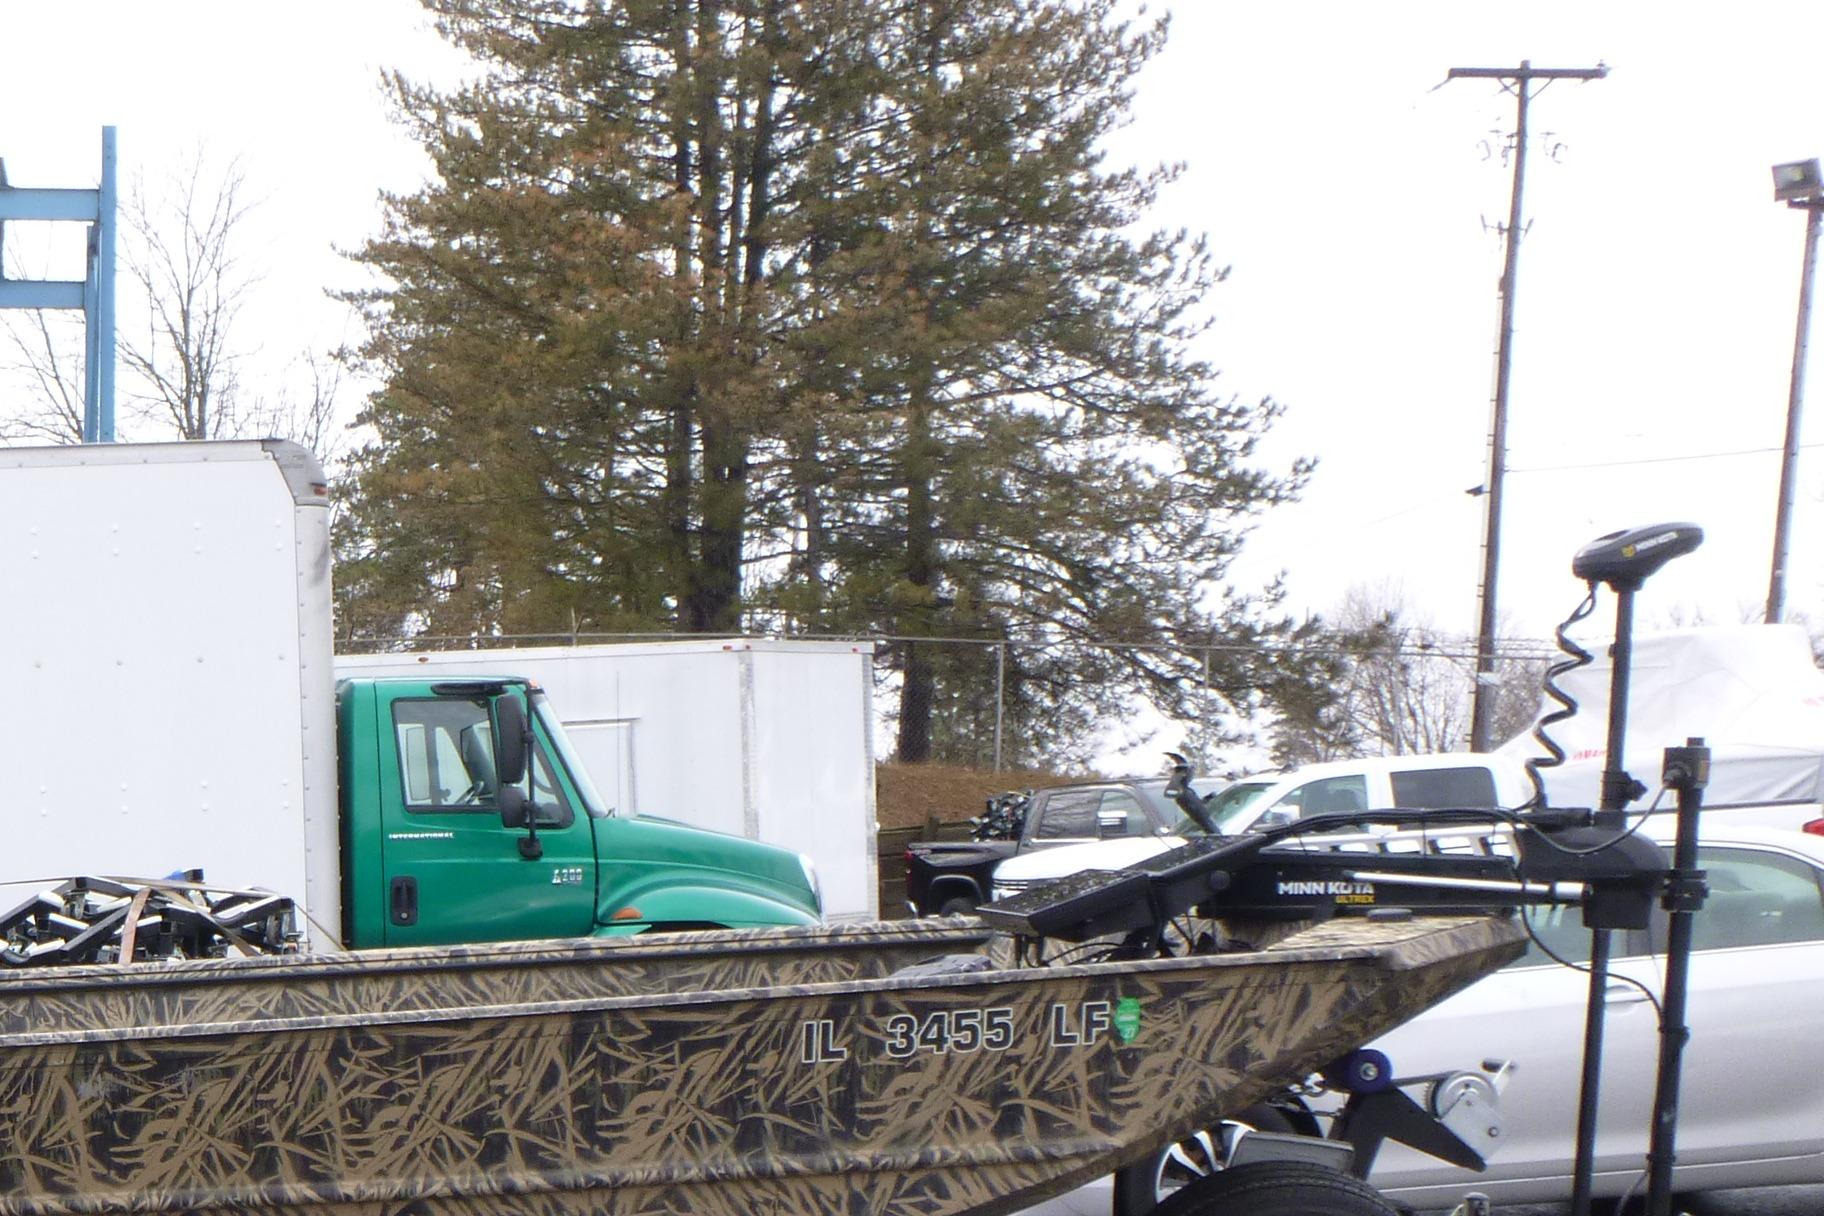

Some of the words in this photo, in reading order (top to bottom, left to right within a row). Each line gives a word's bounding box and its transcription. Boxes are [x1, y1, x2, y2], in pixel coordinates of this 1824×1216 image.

[1277, 882, 1325, 895] MINN
[1327, 881, 1375, 894] KOTA
[801, 1020, 848, 1063] IL
[885, 1008, 1015, 1058] 3455
[1051, 1002, 1110, 1047] LF
